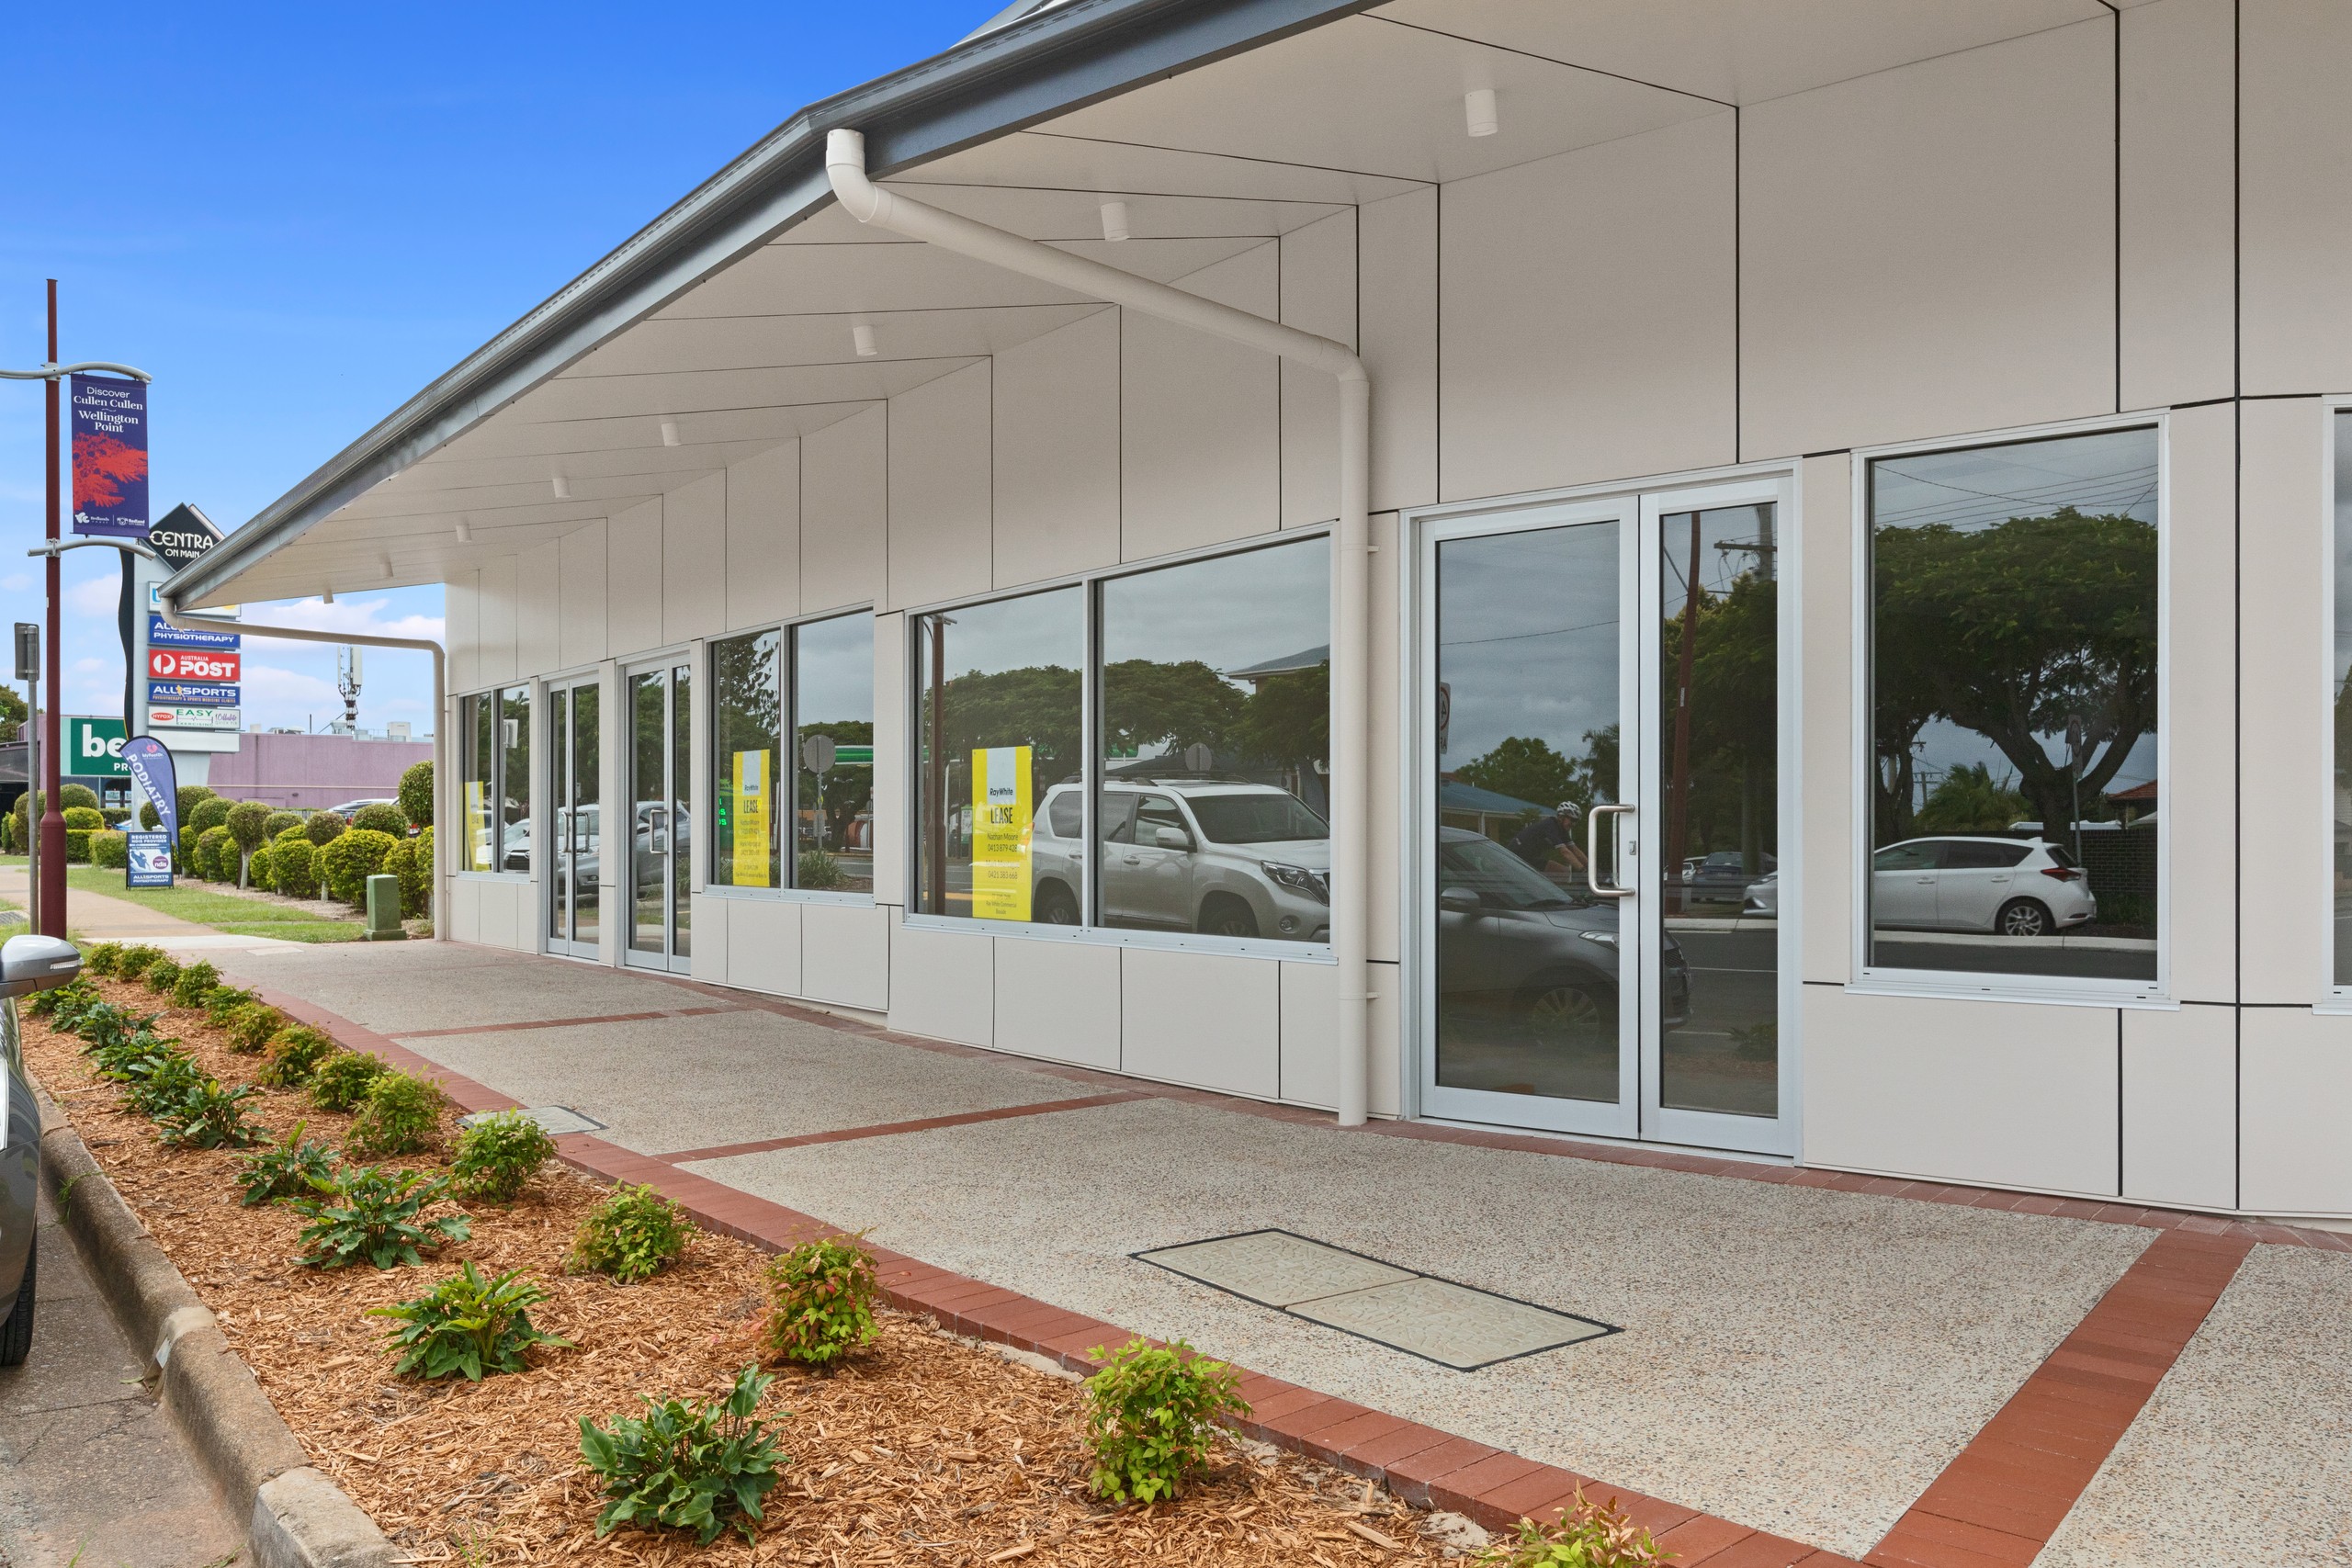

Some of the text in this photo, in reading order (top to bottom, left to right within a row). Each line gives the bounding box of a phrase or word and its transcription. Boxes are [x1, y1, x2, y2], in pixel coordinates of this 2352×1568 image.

[86, 386, 130, 399] Discover
[74, 395, 143, 411] Cullen Cullen
[78, 410, 139, 424] Wellington
[95, 422, 125, 433] Point
[164, 548, 200, 558] ON MAIN
[153, 632, 234, 643] PHYSIOTHERAPY
[180, 660, 235, 677] POST
[176, 708, 213, 716] EASY
[126, 753, 171, 816] PODIATRY
[743, 799, 759, 814] LEASE
[990, 807, 1013, 824] LEASE
[1003, 833, 1019, 841] Moore
